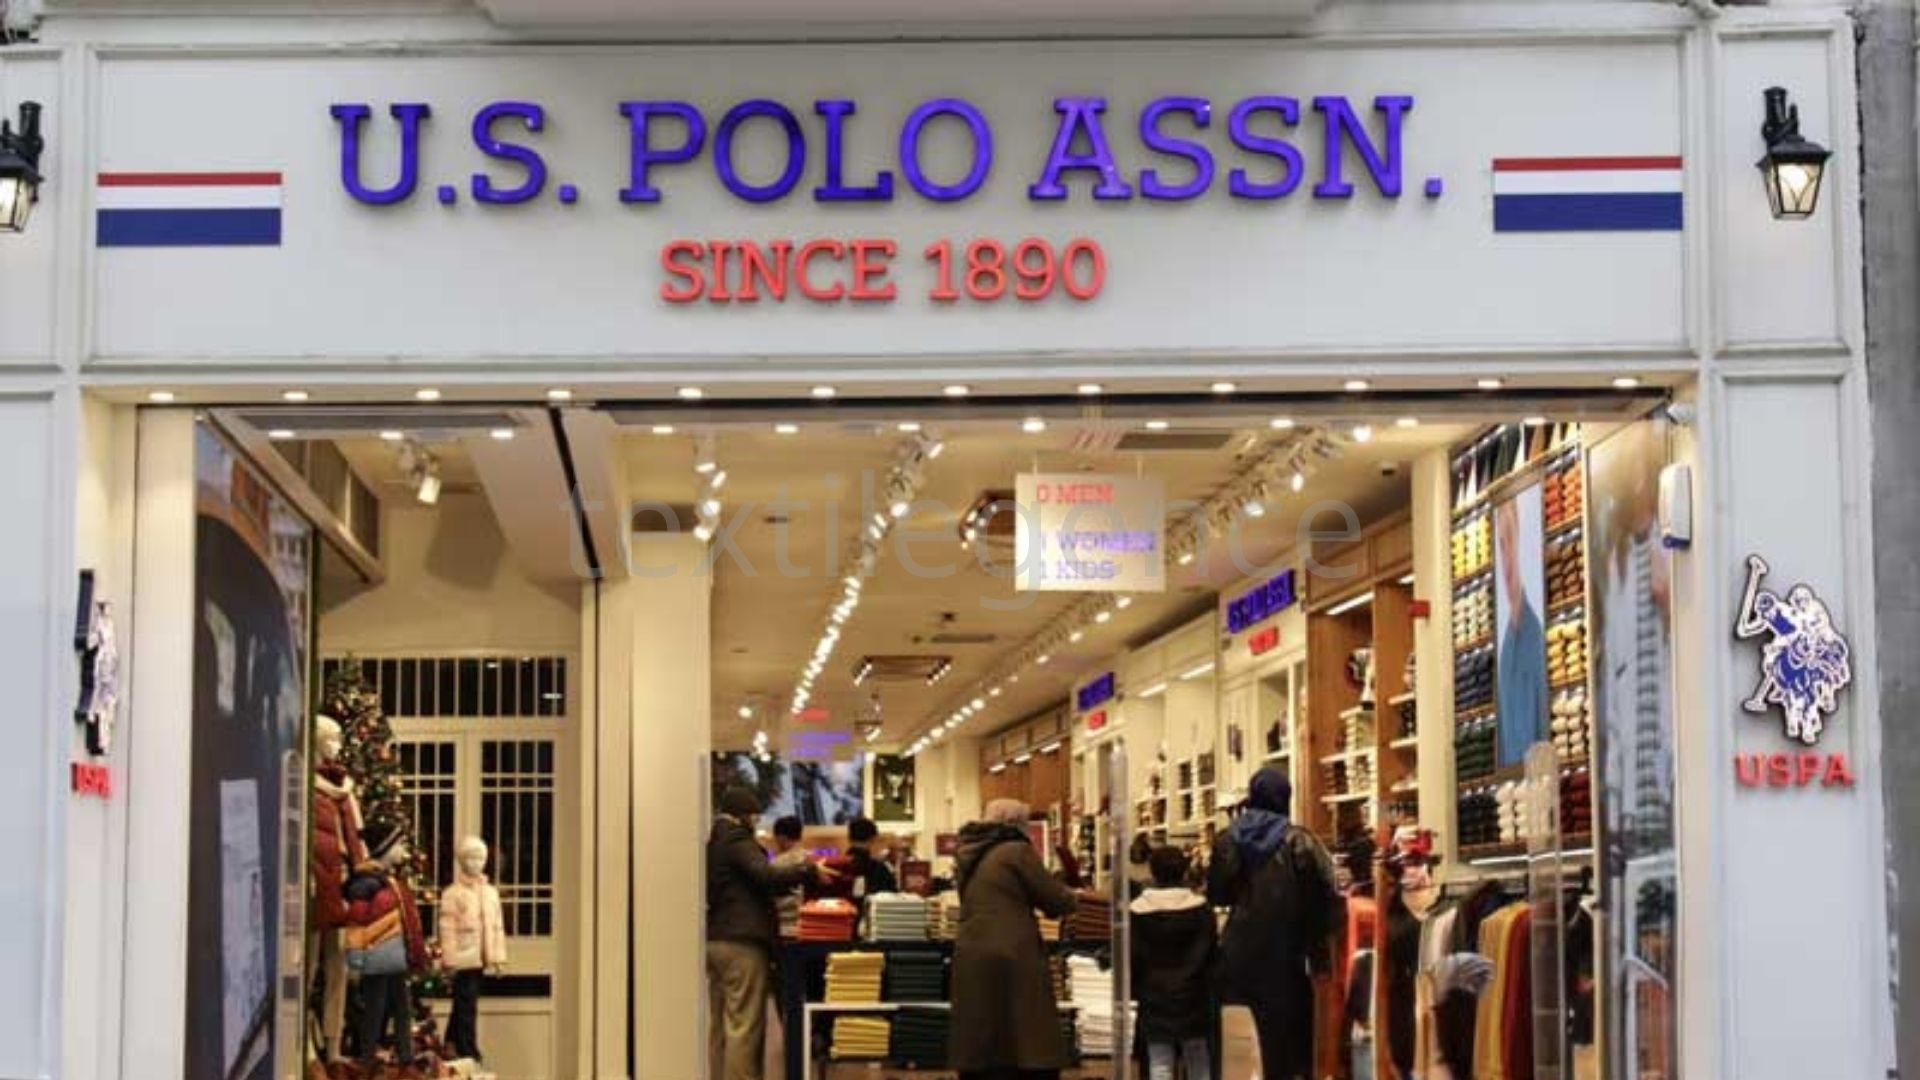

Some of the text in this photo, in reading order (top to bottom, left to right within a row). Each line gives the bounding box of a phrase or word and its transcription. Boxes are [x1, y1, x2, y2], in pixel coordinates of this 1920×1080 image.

[331, 95, 1444, 204] U.S. POLO ASSN.
[659, 236, 1107, 301] SINCE 1890
[1056, 484, 1114, 504] MEN
[1056, 561, 1116, 579] KIDS
[1734, 752, 1855, 788] USPA
